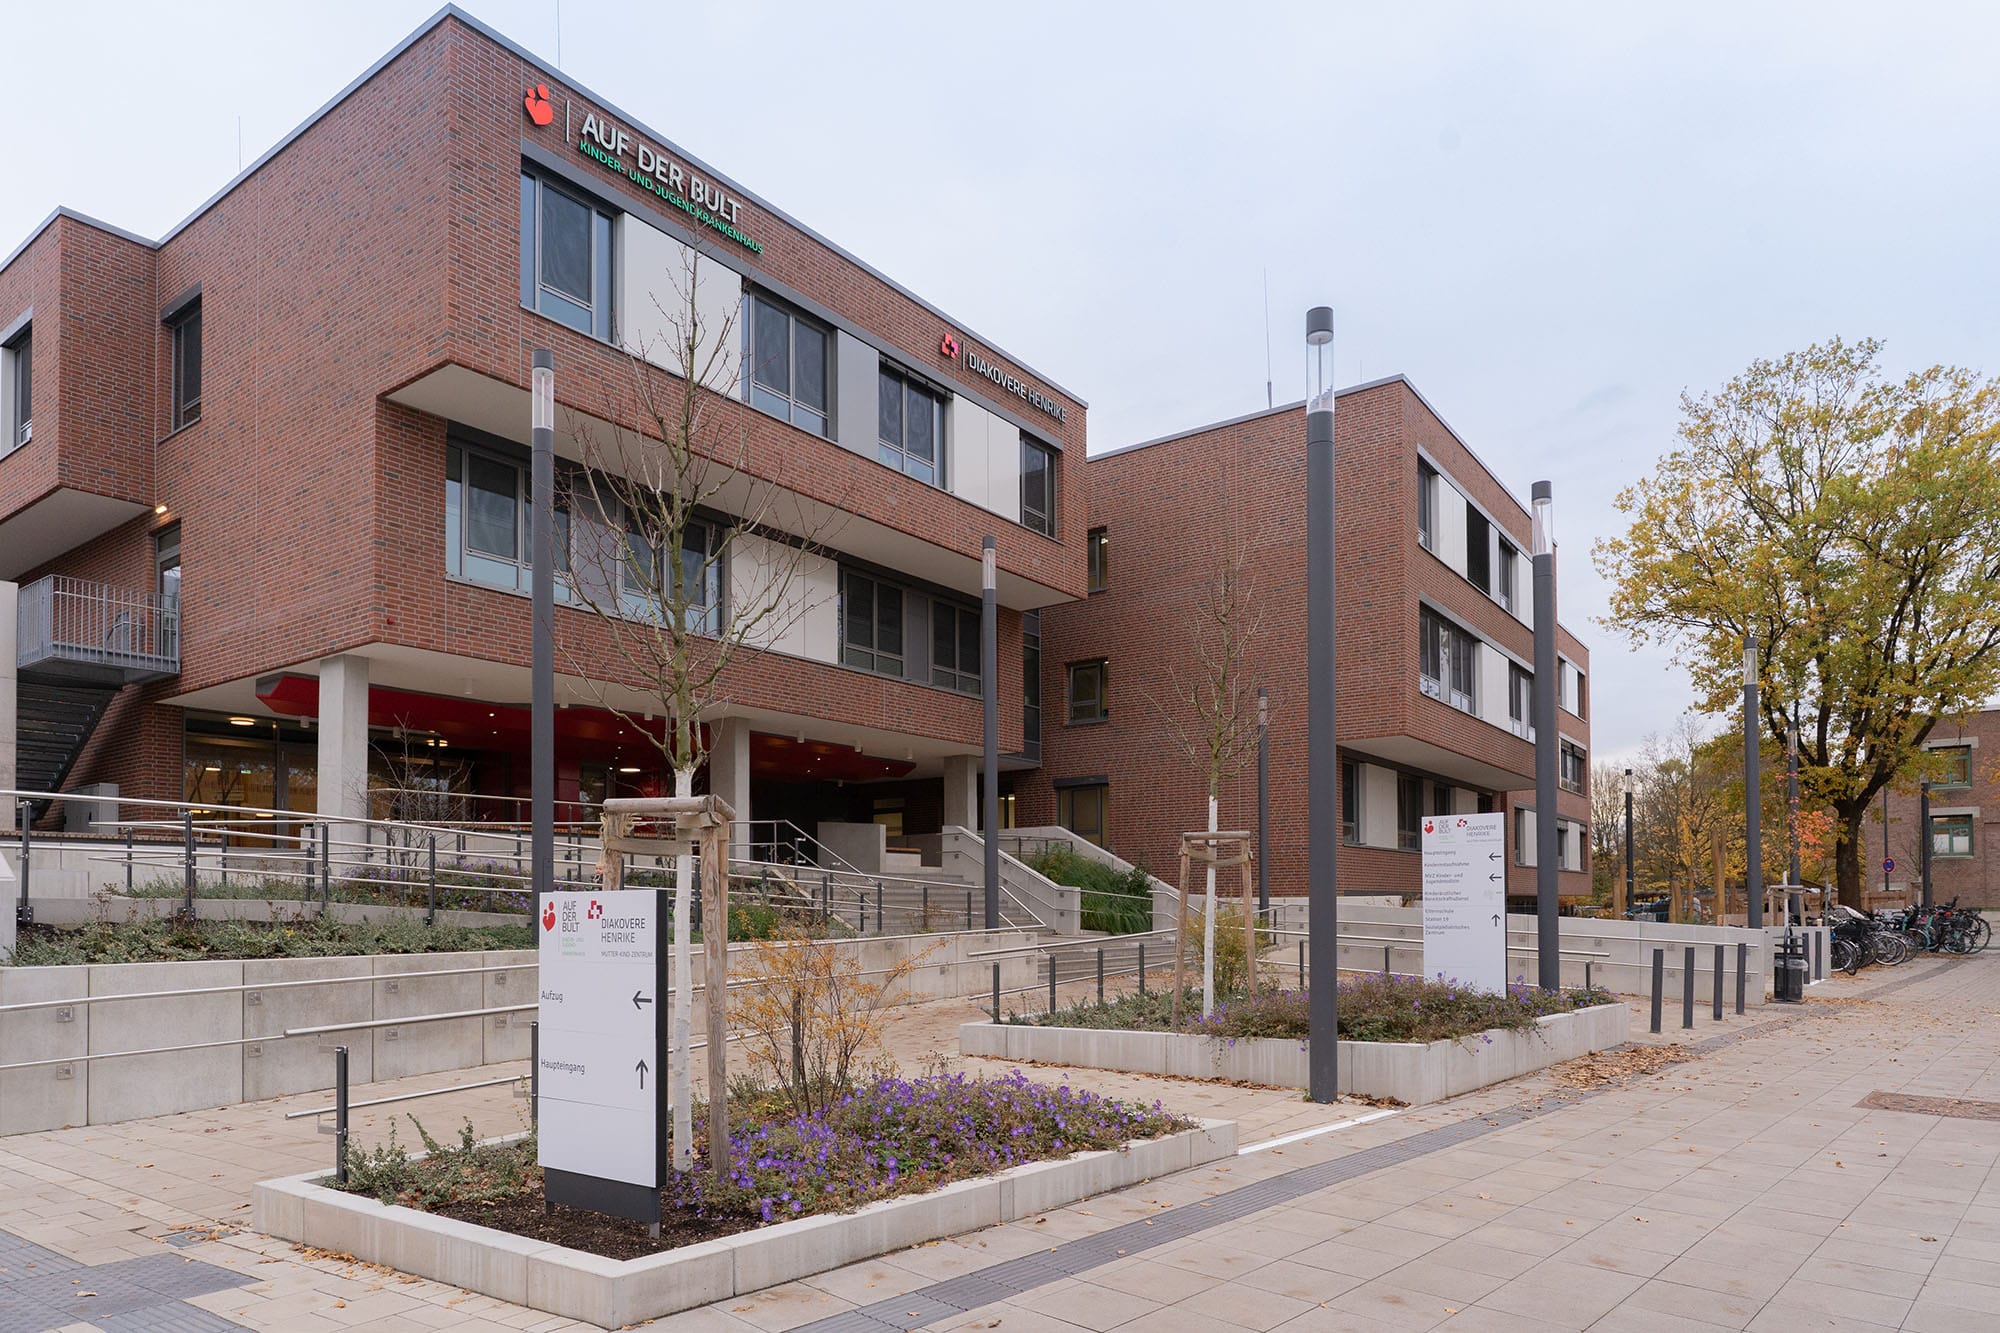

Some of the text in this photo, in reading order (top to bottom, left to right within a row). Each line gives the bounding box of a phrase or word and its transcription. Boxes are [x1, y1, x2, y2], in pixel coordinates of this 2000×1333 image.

[580, 112, 742, 225] AUF DER BULT
[579, 139, 764, 254] KINDER- UND JUGENDKRANKENHAUS
[968, 351, 1067, 423] DIAKOVERE HENRIKE
[562, 900, 577, 911] AUF
[562, 911, 577, 922] DER
[562, 922, 580, 933] BULT
[601, 918, 646, 930] DIAKOVERE
[601, 932, 636, 943] HENRIKE
[541, 990, 563, 1003] Aufzug
[541, 1059, 586, 1076] Haupteingang
